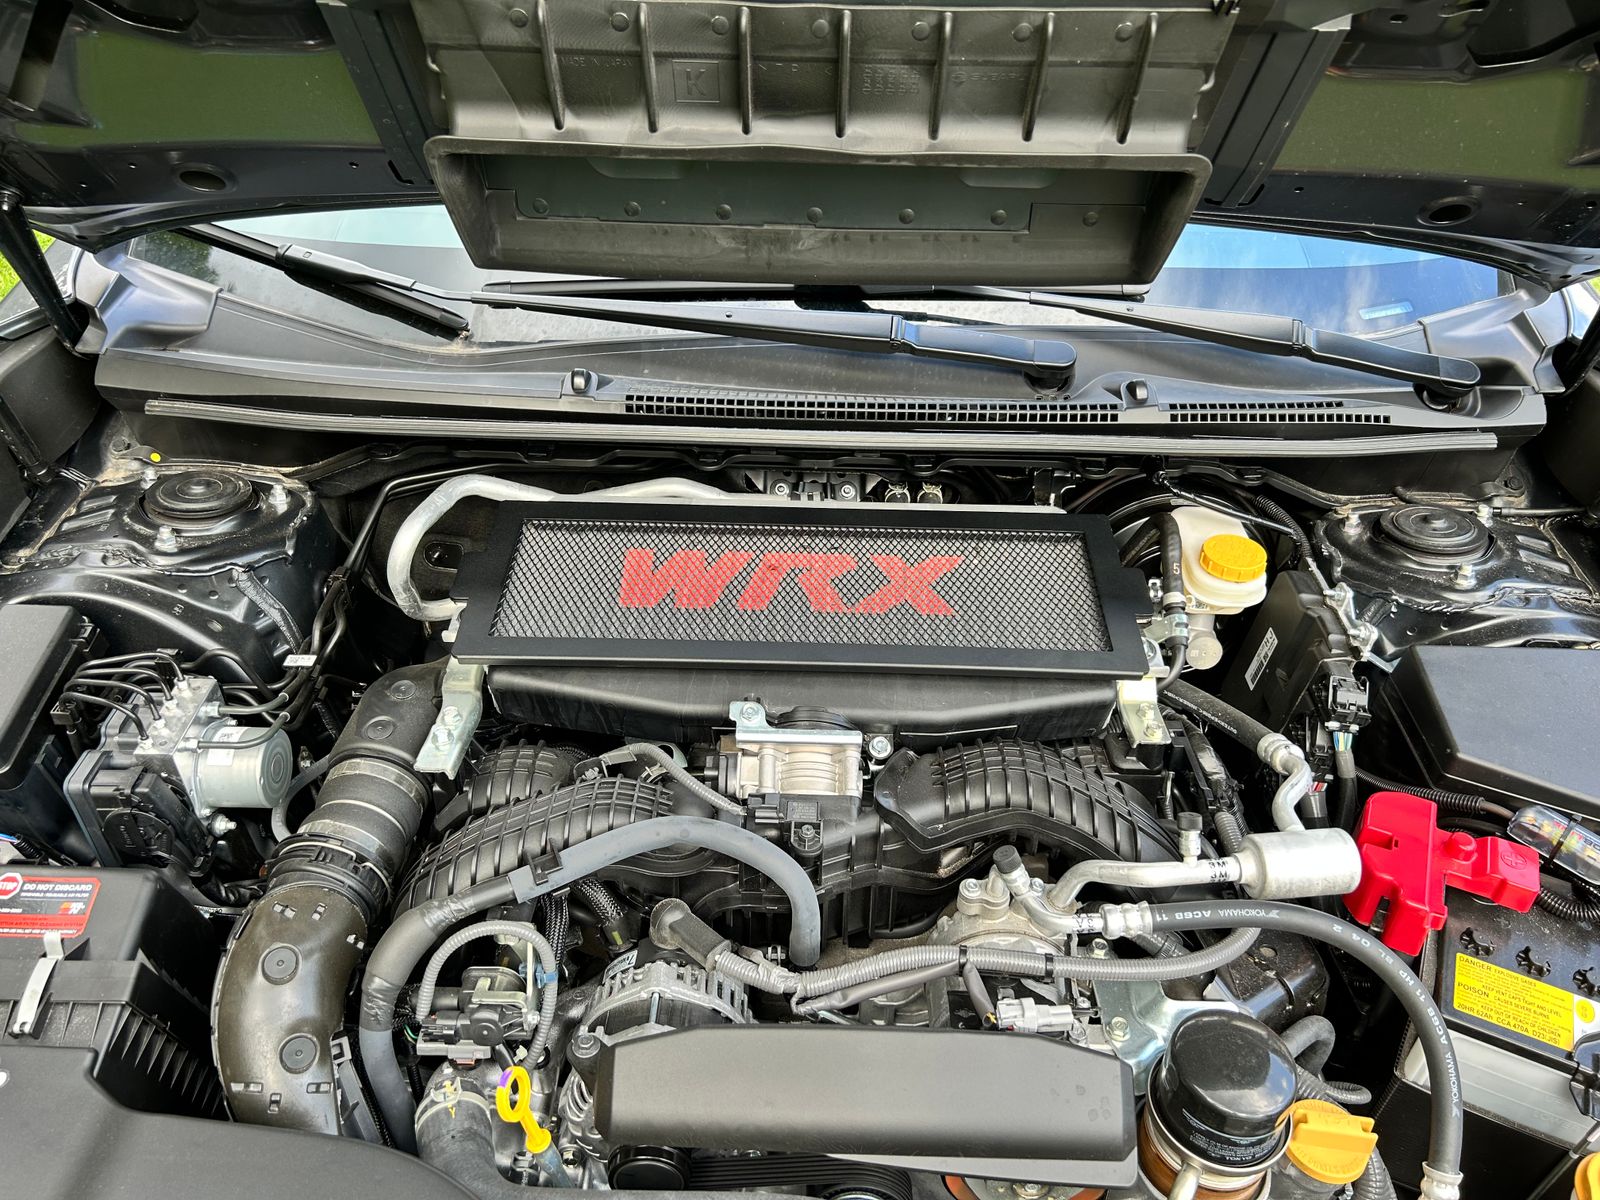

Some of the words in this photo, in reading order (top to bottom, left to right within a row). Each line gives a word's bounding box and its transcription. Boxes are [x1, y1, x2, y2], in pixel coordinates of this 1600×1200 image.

[686, 68, 707, 96] K
[618, 548, 966, 618] WRX
[23, 883, 36, 891] DO
[37, 883, 54, 891] NOT
[54, 884, 93, 892] DISCARD
[1217, 908, 1266, 918] YOKOHAMA
[1459, 955, 1492, 971] DANGER
[1494, 967, 1519, 981] EXPLOSIVE
[1520, 976, 1537, 987] GASES
[1458, 981, 1490, 998] POISON
[1482, 984, 1495, 992] KEEP
[1495, 988, 1507, 997] VENT
[1508, 992, 1521, 1002] CAPS
[1521, 997, 1536, 1007] TIGHT
[1537, 1003, 1548, 1012] AND
[1548, 1007, 1562, 1018] LEVEL
[1494, 995, 1514, 1007] CAUSES
[1514, 1001, 1532, 1014] SEVERE
[1480, 1004, 1494, 1014] KEEP
[1512, 1015, 1529, 1026] REACH
[1537, 1024, 1561, 1038] CHILDREN
[1496, 1016, 1512, 1028] CCA
[1445, 1050, 1460, 1104] YOKOHAMA
